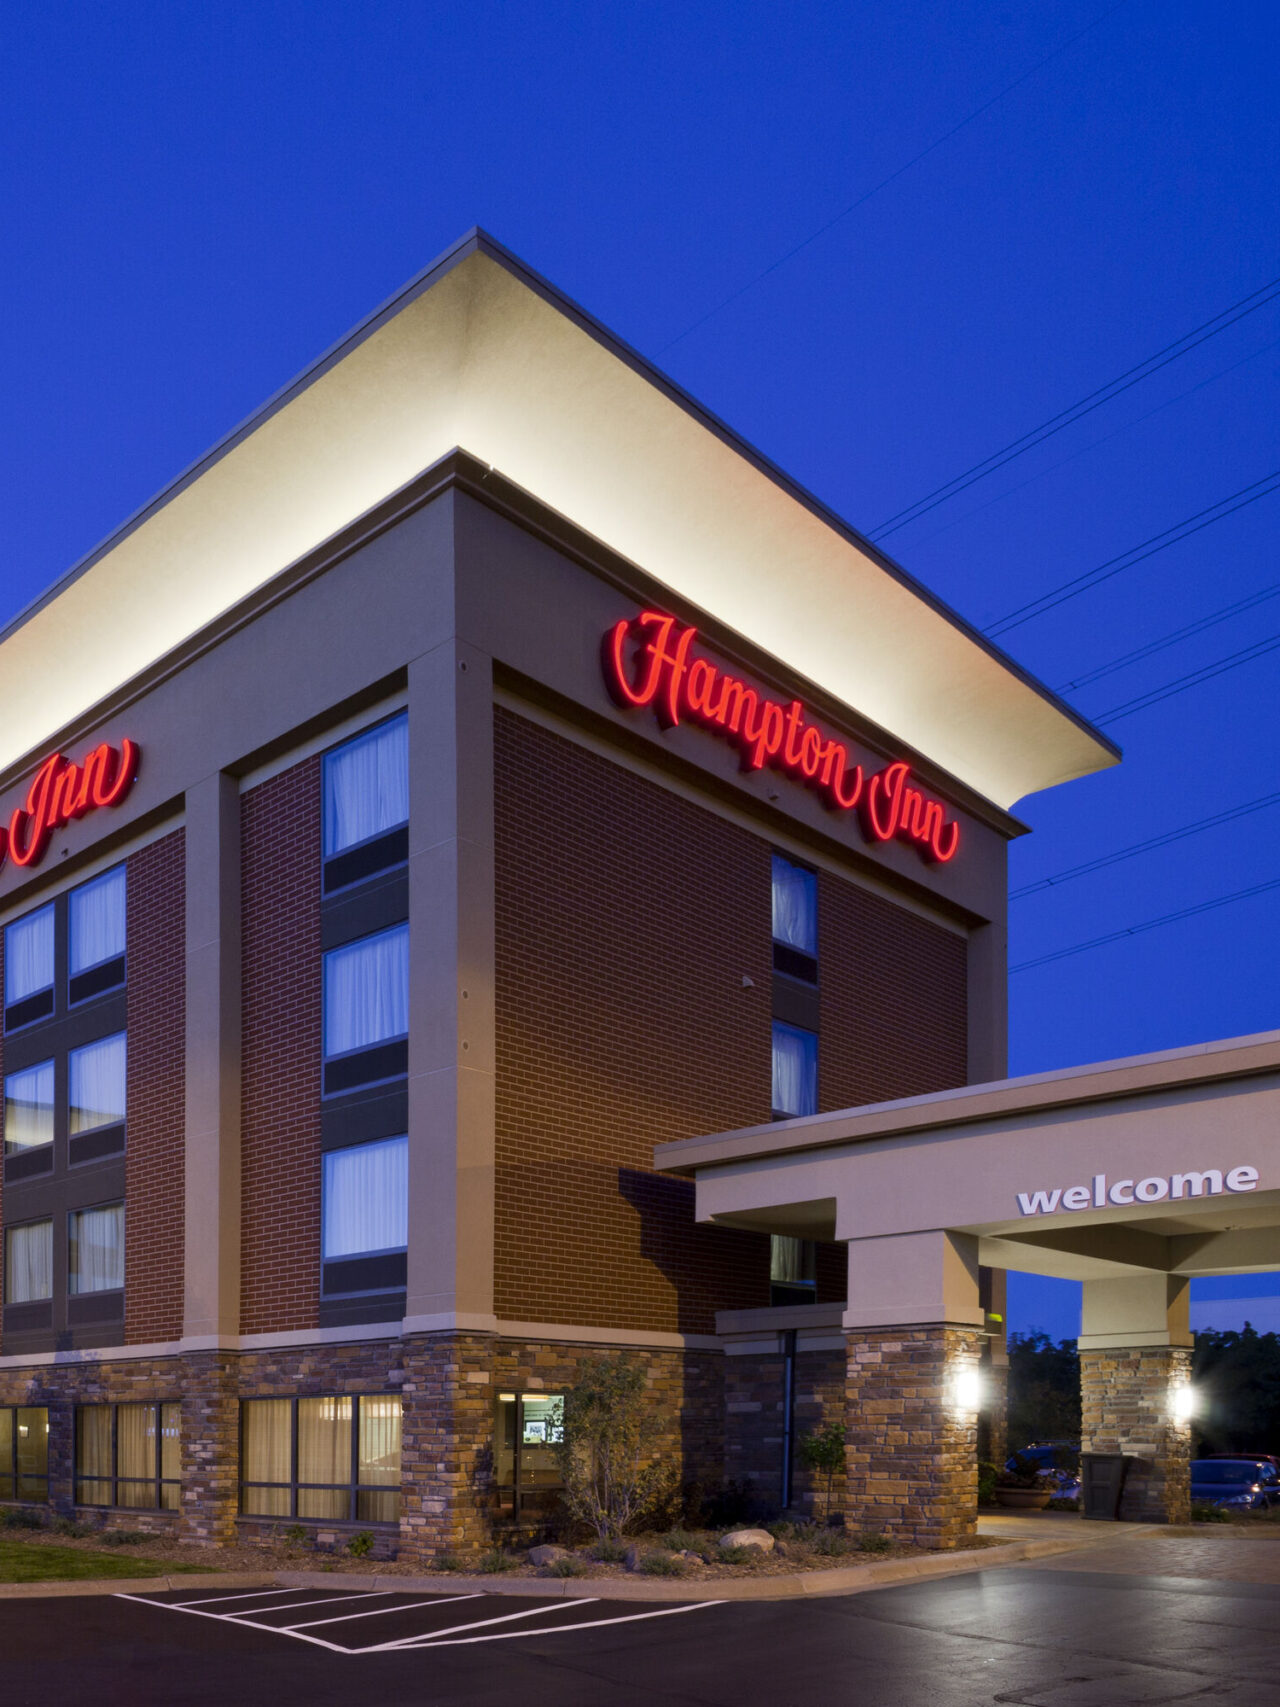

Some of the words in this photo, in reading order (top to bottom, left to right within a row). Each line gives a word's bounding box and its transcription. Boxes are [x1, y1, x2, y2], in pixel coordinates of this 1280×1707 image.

[608, 610, 863, 808] Hampton
[866, 760, 960, 862] Inn
[8, 738, 141, 867] Inn
[1017, 1164, 1260, 1217] welcome
